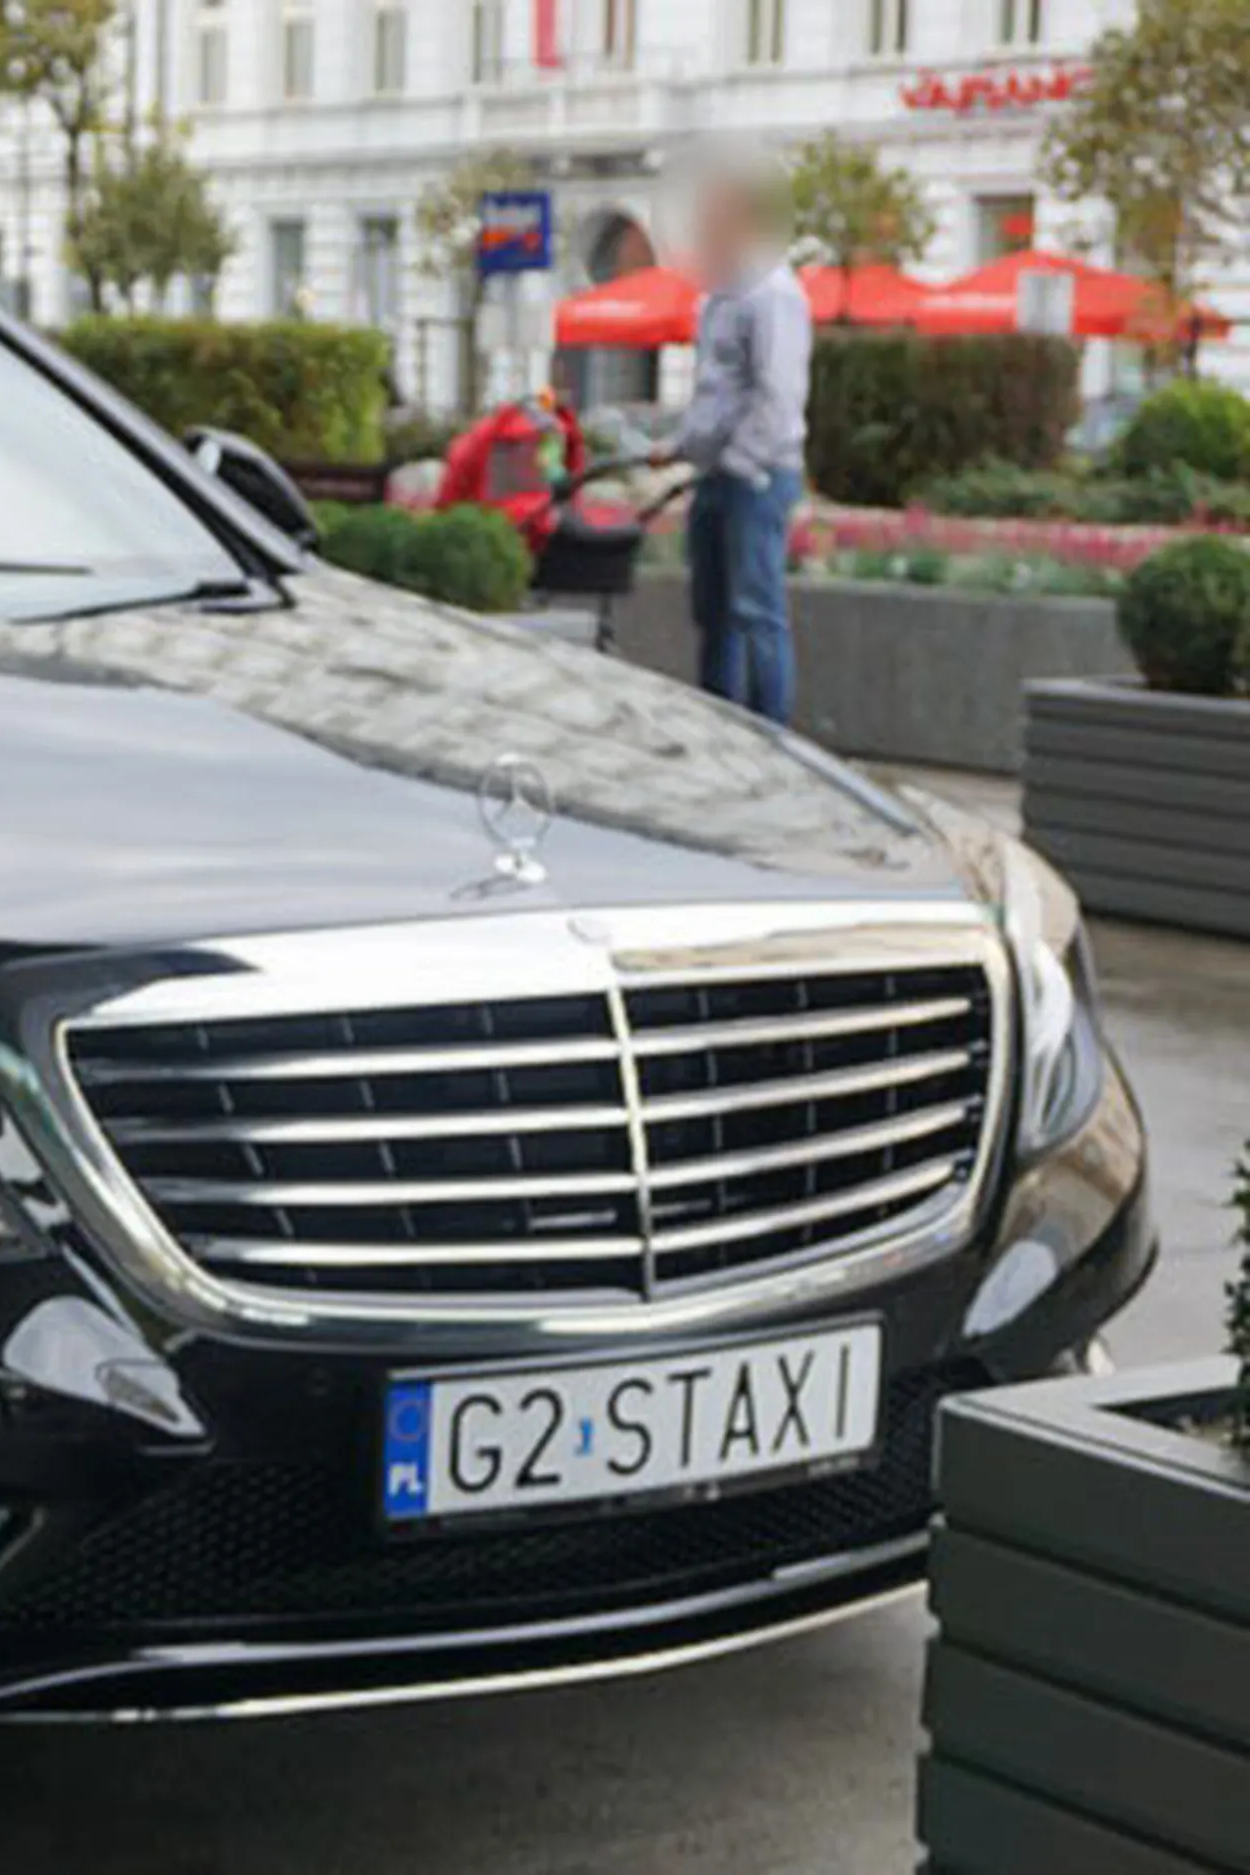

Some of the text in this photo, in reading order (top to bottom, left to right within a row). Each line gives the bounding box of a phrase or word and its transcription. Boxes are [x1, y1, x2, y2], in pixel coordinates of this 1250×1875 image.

[449, 1343, 852, 1493] G2 STAXI
[388, 1463, 424, 1497] PL
